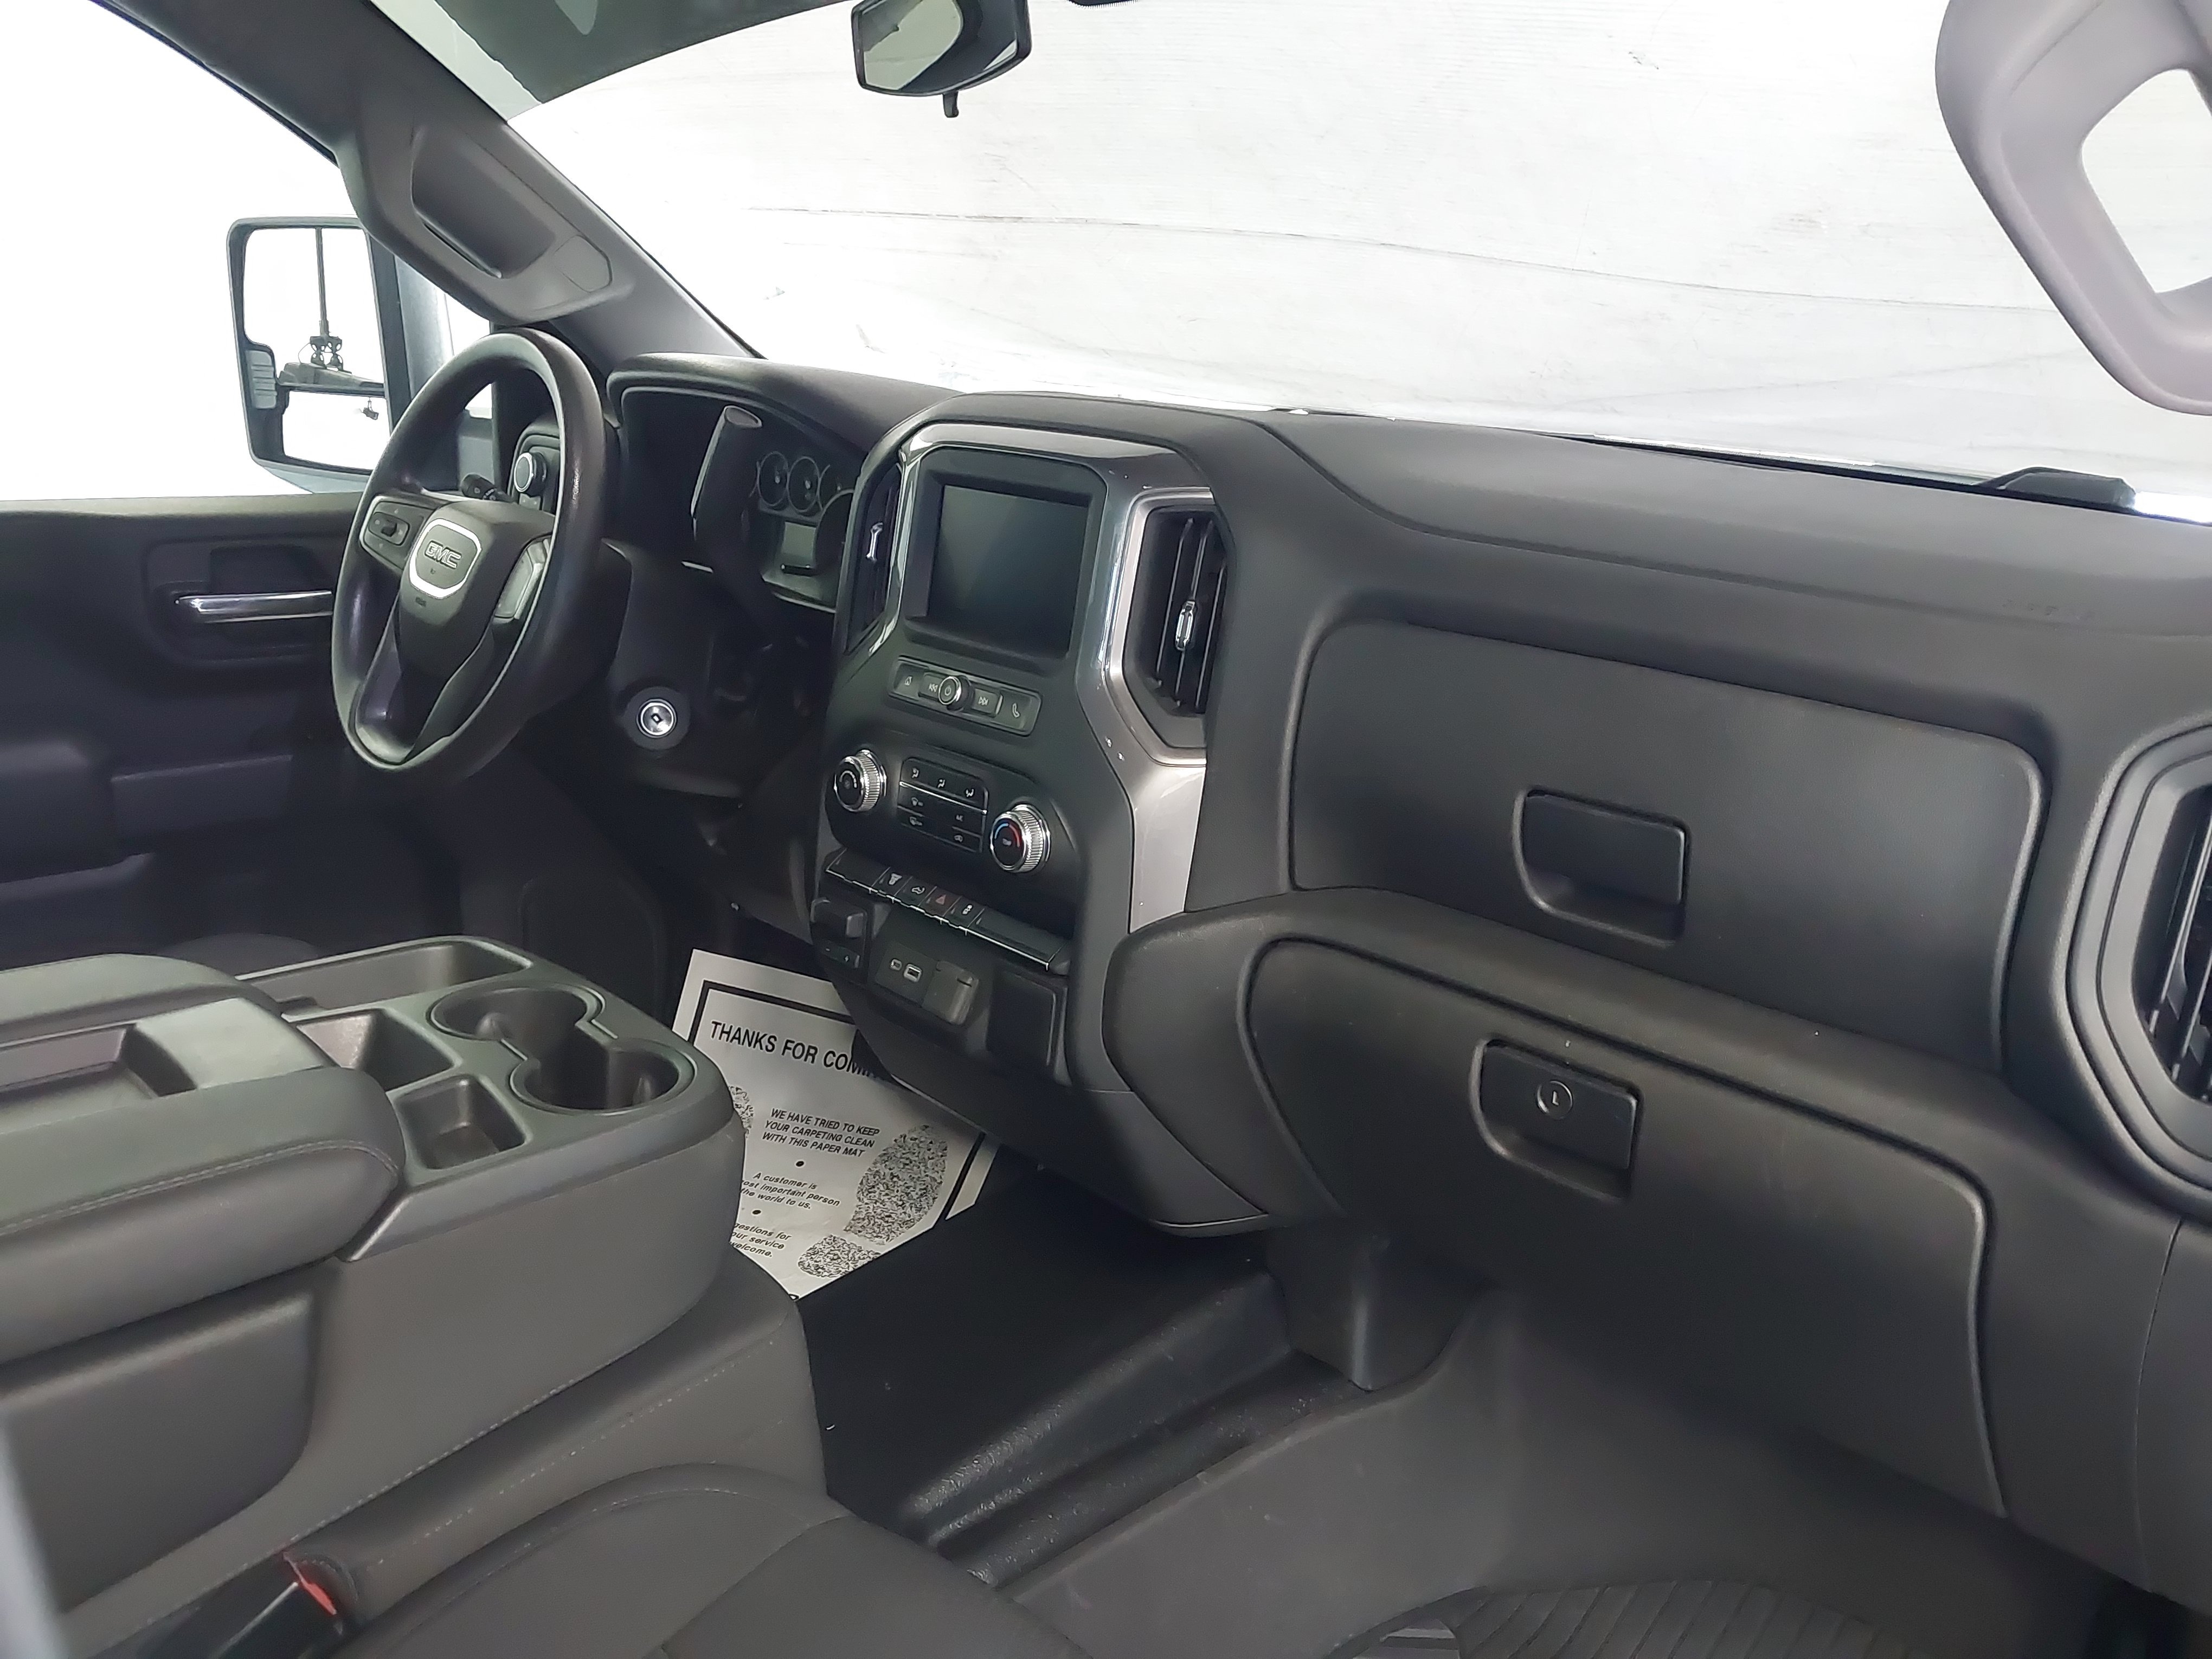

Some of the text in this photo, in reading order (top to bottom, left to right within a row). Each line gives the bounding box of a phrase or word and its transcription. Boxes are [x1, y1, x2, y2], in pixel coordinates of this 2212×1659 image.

[425, 541, 462, 569] GMC
[711, 1020, 777, 1053] THANKS
[781, 1039, 818, 1064] FOR
[764, 1120, 875, 1148] YOUR CARPETING CLEAN
[770, 1108, 880, 1136] WE HAVE TRIED TO KEEP
[762, 1131, 866, 1157] WITH THIS PAPER MAT
[763, 1175, 807, 1188] customer
[741, 1188, 755, 1197] the
[757, 1193, 786, 1203] world
[798, 1201, 811, 1209] us.
[760, 1184, 806, 1197] important
[806, 1193, 841, 1206] person
[749, 1237, 785, 1249] service
[775, 1232, 792, 1240] for
